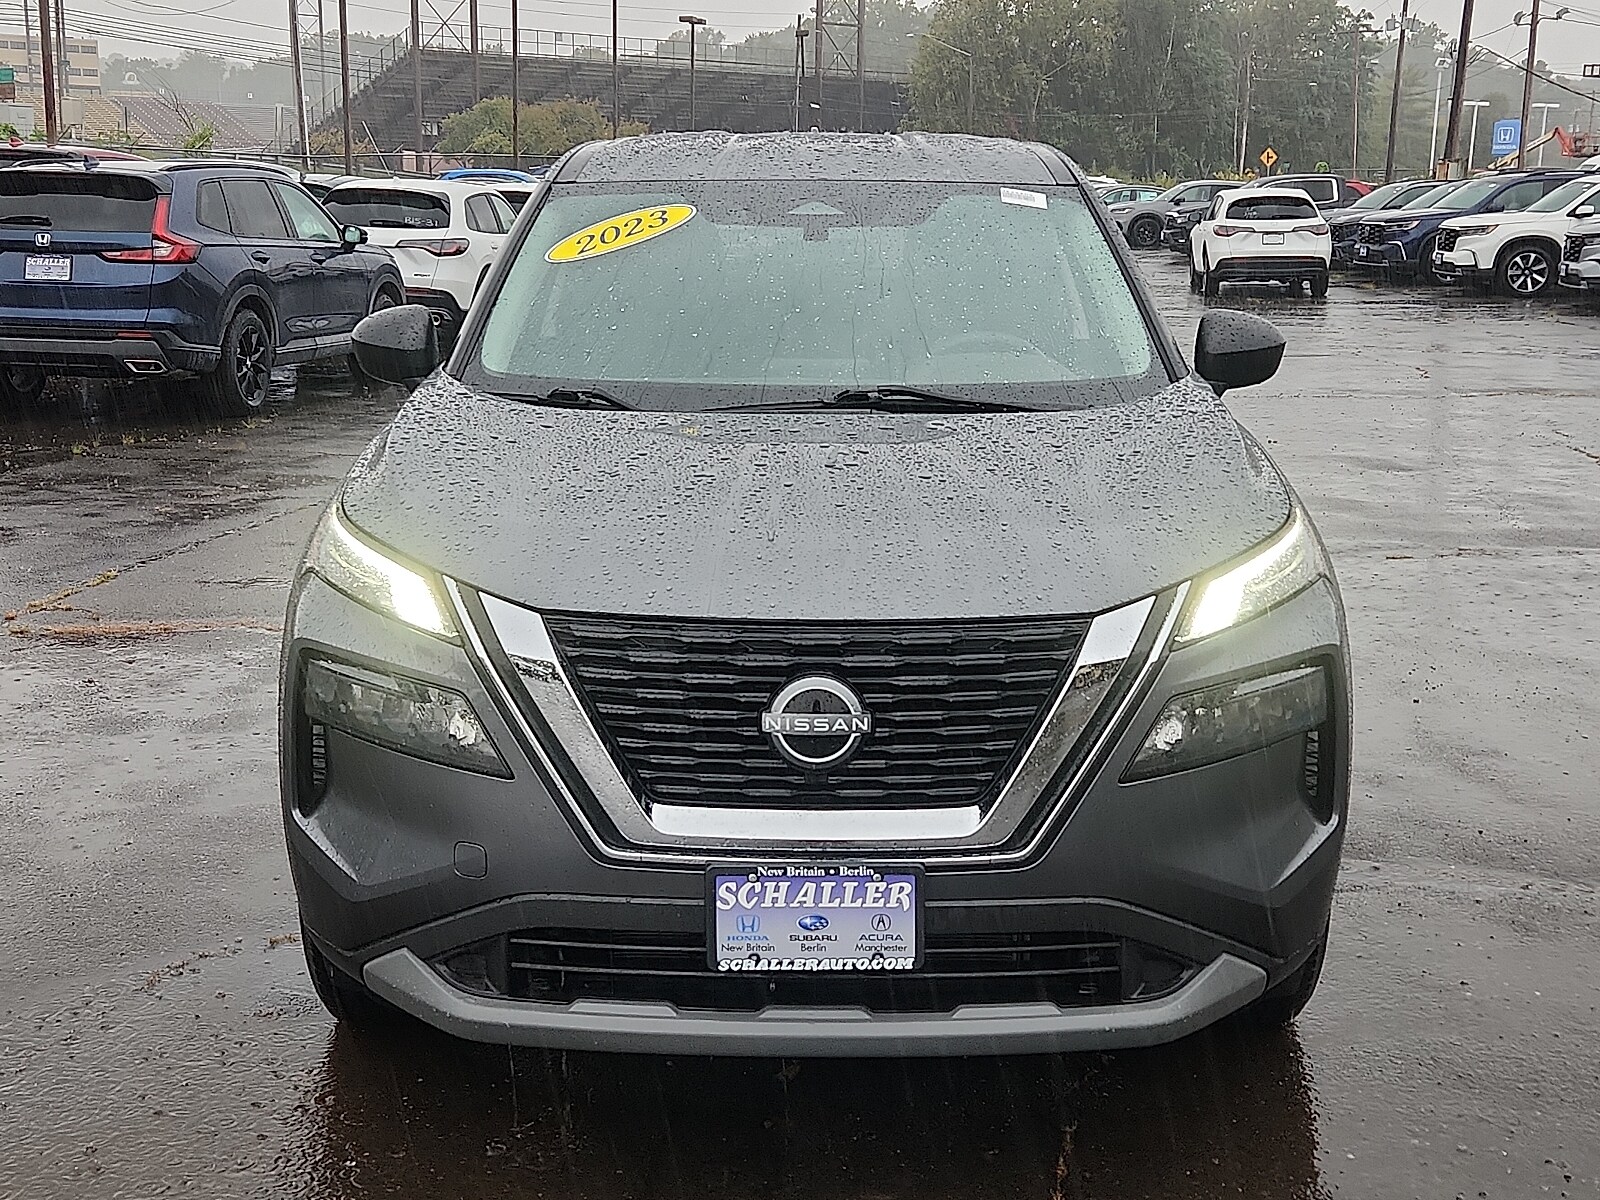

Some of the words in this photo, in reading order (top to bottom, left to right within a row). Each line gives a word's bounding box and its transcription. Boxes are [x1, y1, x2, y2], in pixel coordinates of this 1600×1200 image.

[576, 210, 669, 255] 2023
[26, 257, 70, 266] SCHALLER
[765, 716, 868, 732] NISSAN
[757, 866, 785, 877] New
[786, 866, 825, 876] Britain
[839, 866, 874, 877] Berlin
[716, 881, 913, 912] SCHALLER
[726, 934, 769, 942] HONDA
[789, 934, 838, 942] SUBARU
[858, 933, 904, 942] ACURA
[721, 943, 744, 952] New
[746, 943, 776, 953] Britain
[800, 943, 827, 952] Berlin
[854, 943, 908, 953] Manchester
[717, 957, 915, 971] SCHALLERAUTO.COM
